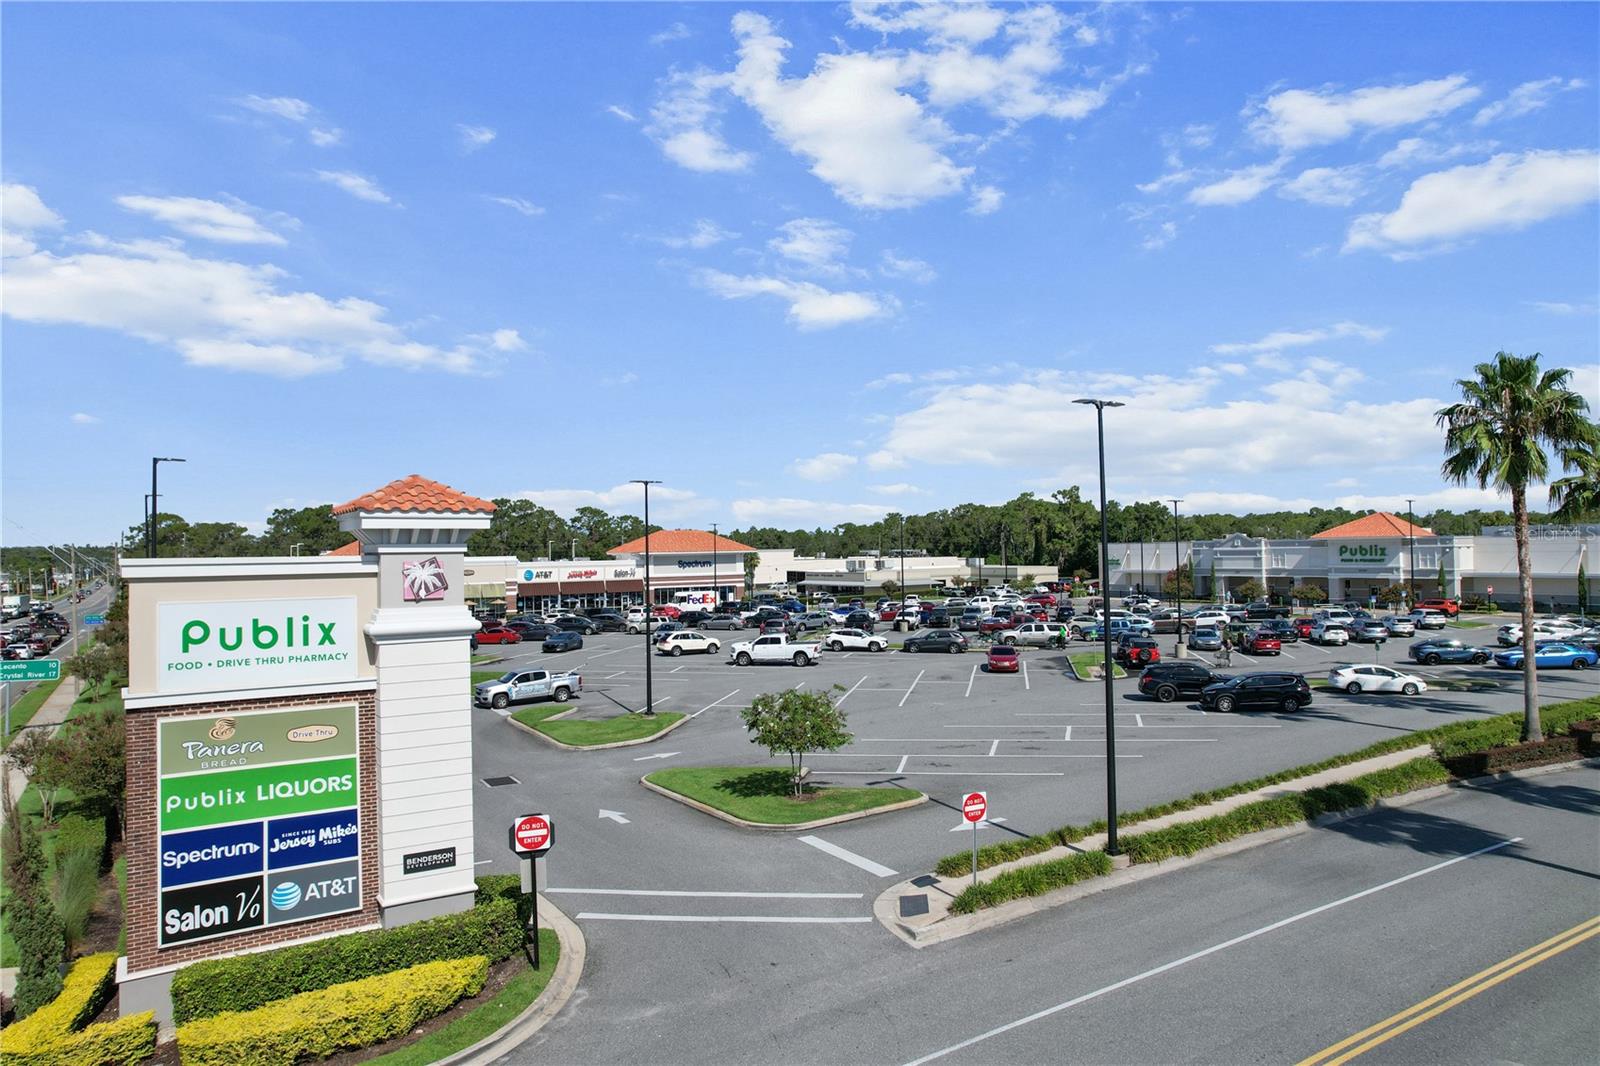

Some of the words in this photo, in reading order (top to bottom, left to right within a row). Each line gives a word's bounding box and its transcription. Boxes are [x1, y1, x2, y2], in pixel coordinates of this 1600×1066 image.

[1339, 544, 1387, 557] Publix
[677, 559, 712, 570] Spectrum
[535, 570, 552, 579] AT&T
[687, 593, 716, 605] FedEx
[182, 614, 336, 653] Publix
[167, 661, 203, 671] FOOD
[216, 658, 251, 668] DRIVE
[255, 656, 284, 666] THRU
[288, 652, 349, 663] PHARMACY
[292, 731, 313, 739] Drive
[315, 729, 333, 737] Thru
[182, 739, 264, 760] Panera
[201, 757, 247, 769] BREAD
[166, 788, 246, 813] Publix
[256, 774, 353, 801] LIQUORS
[269, 834, 316, 853] Jersey
[318, 823, 358, 841] Mike's
[323, 838, 342, 846] SUBS
[162, 841, 256, 869] Spectrum
[406, 851, 454, 866] BENDERSON
[304, 876, 357, 902] AT&T
[165, 904, 229, 935] Salon
